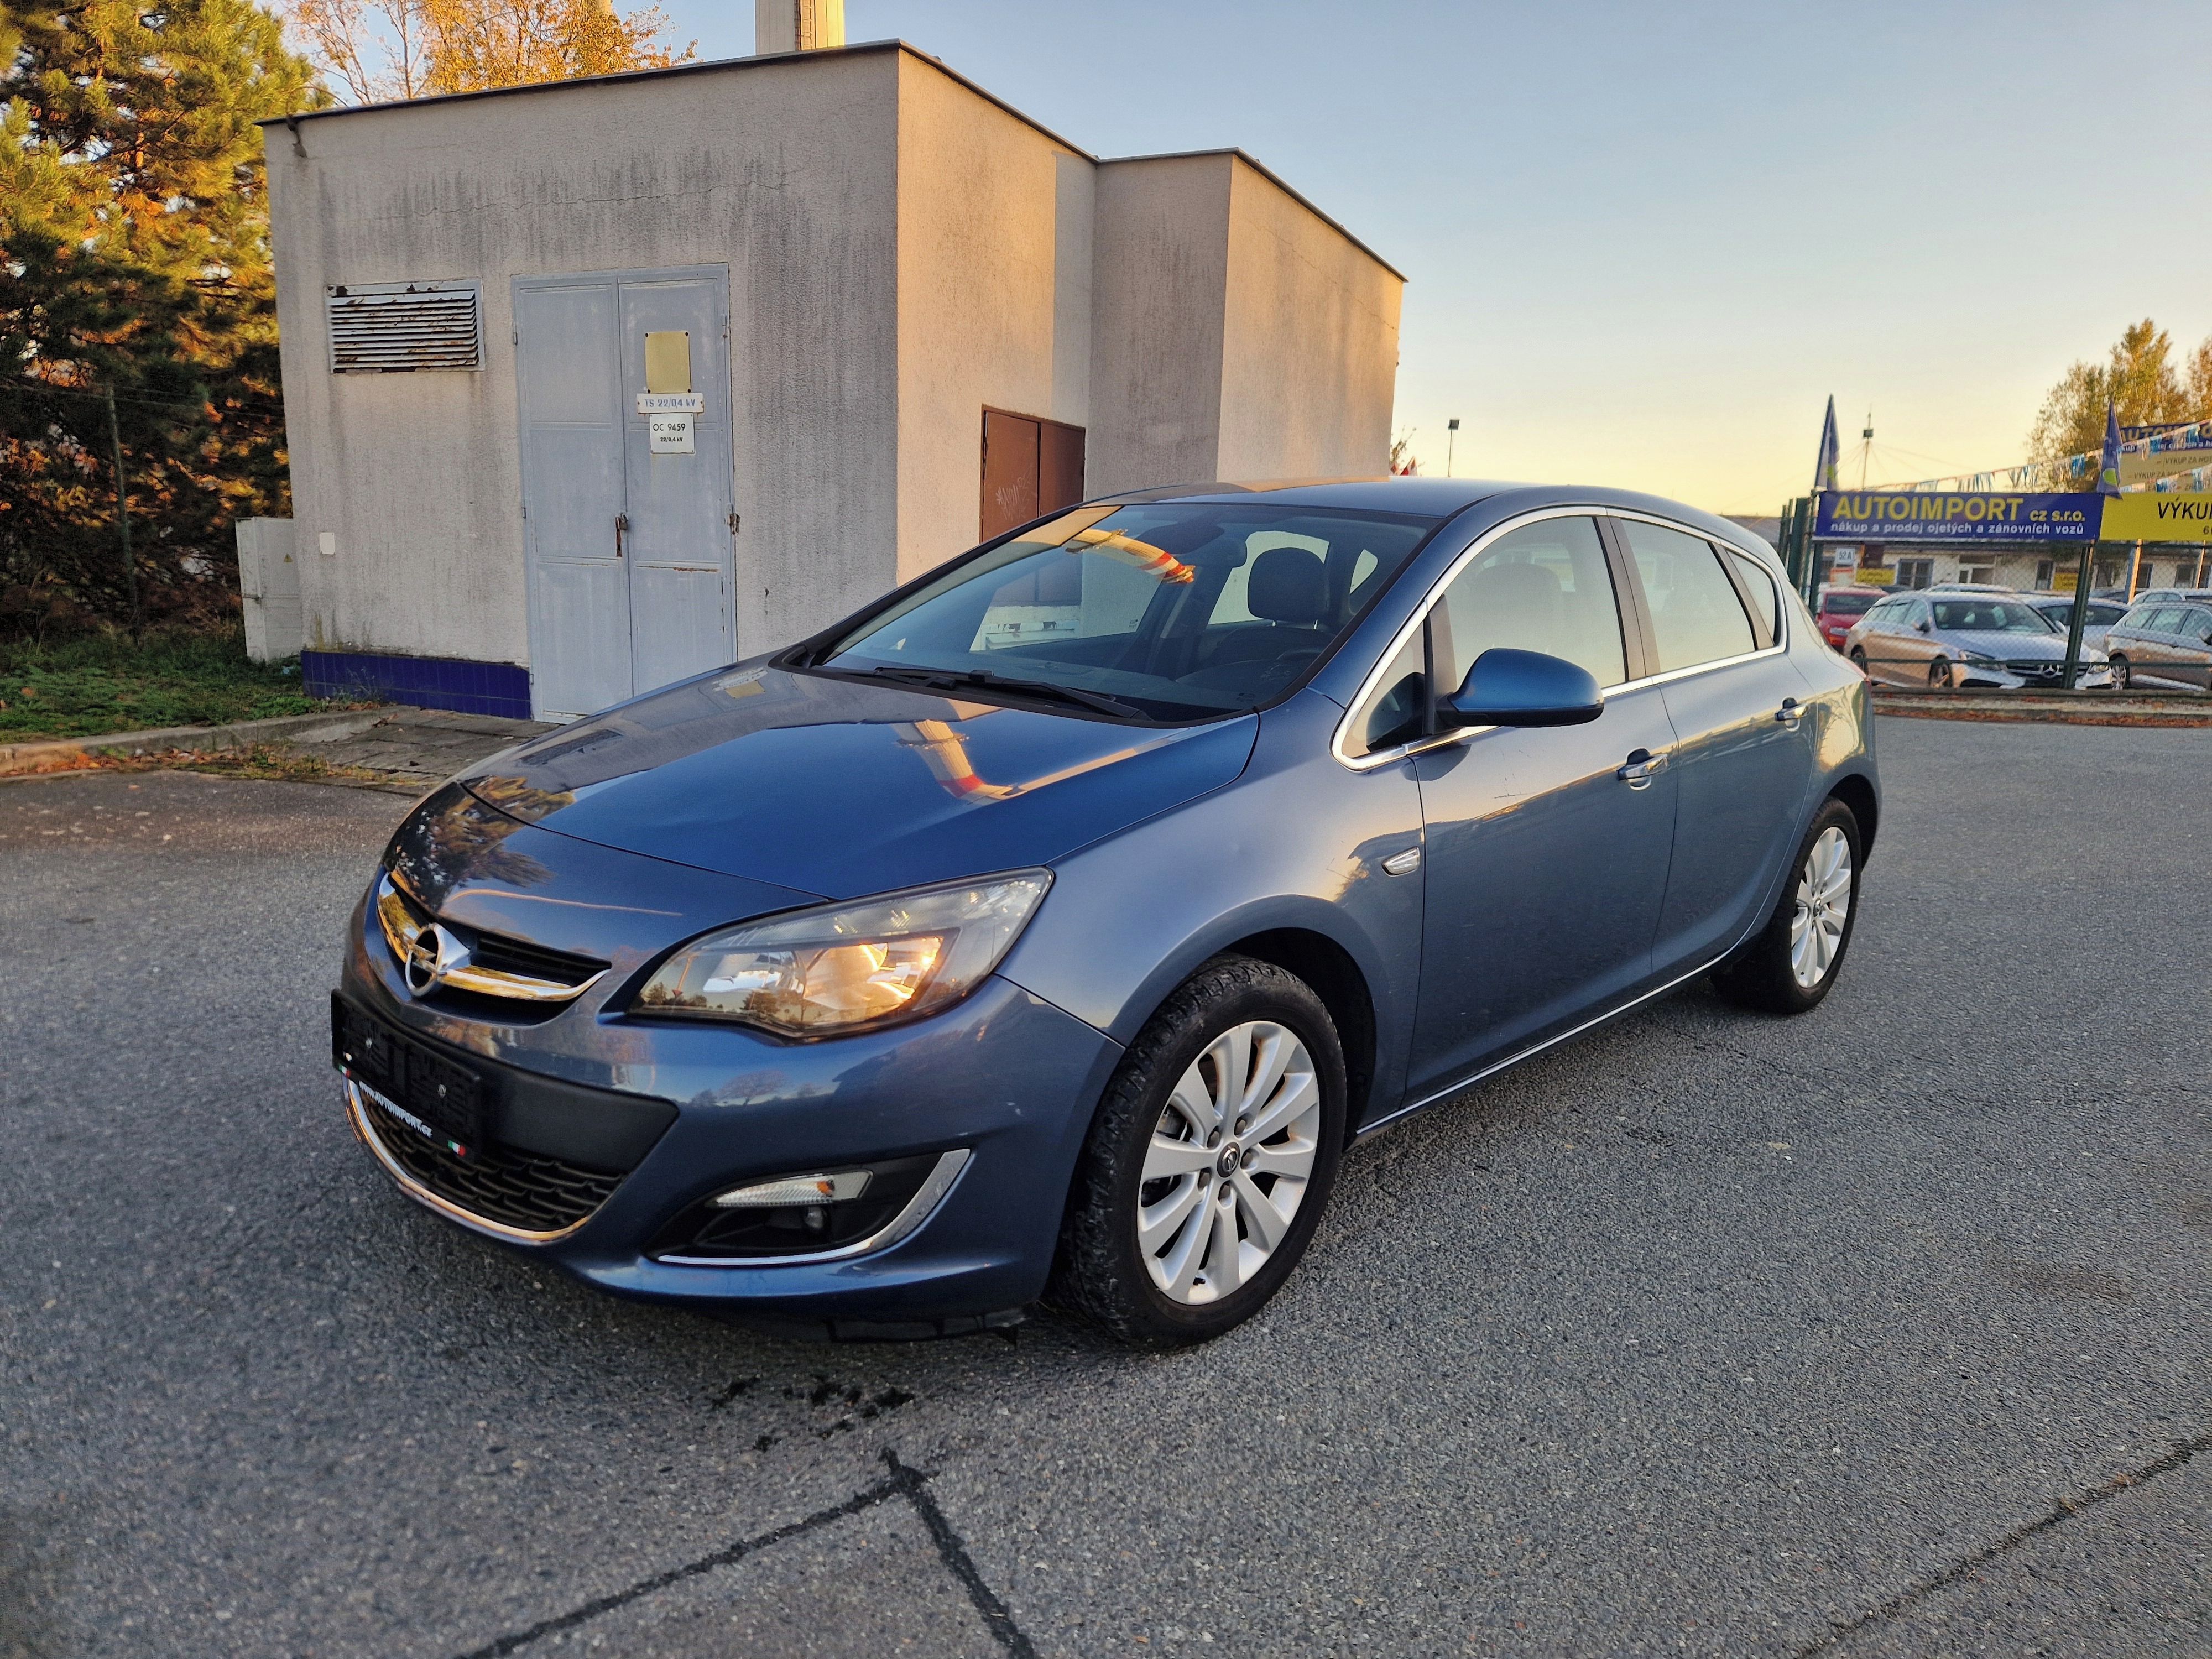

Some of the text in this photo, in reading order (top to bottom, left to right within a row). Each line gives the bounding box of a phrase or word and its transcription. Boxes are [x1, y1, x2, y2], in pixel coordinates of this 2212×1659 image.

[645, 397, 696, 409] TS 22/0,4 kV
[667, 423, 686, 431] 9459
[1832, 495, 2085, 522] AUTOIMPORT cz s.r.o.
[2158, 495, 2212, 519] VÝKU
[1830, 521, 2084, 535] nákup a prodej ojetých a zánovních vozů
